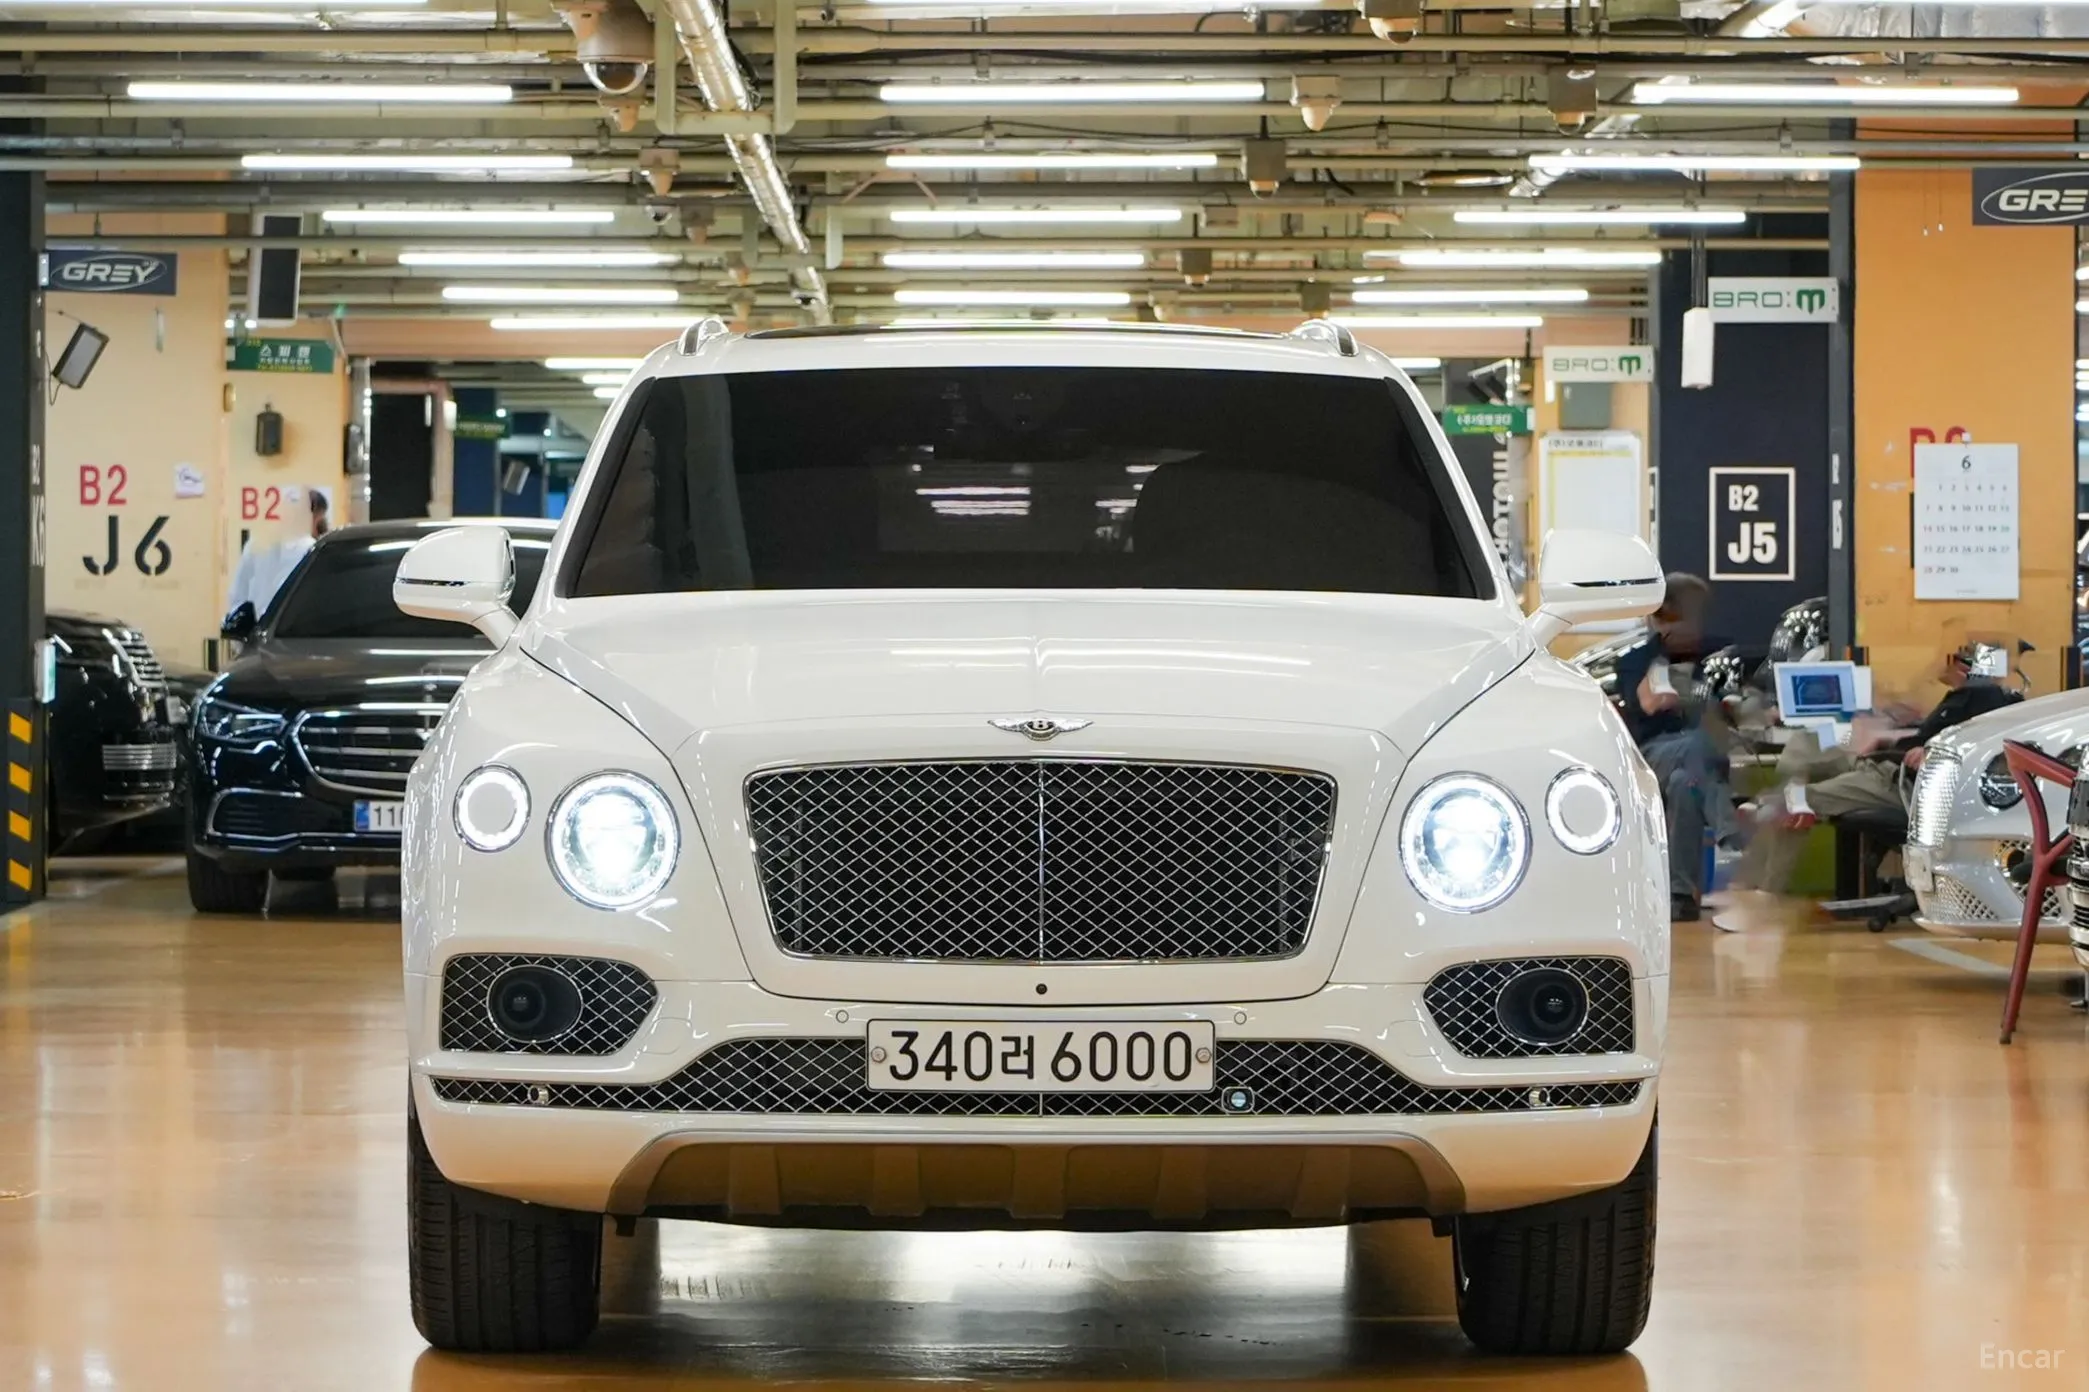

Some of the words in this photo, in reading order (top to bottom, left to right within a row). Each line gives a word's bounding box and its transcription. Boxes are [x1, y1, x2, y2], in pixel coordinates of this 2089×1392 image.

[62, 260, 160, 283] GREY
[1961, 455, 1972, 470] 6
[79, 464, 128, 505] B2
[241, 486, 281, 520] B2
[1728, 484, 1759, 511] B2
[82, 515, 173, 576] J6
[1728, 522, 1778, 564] J5
[889, 1030, 1034, 1082] 340러
[1050, 1031, 1192, 1082] 6000
